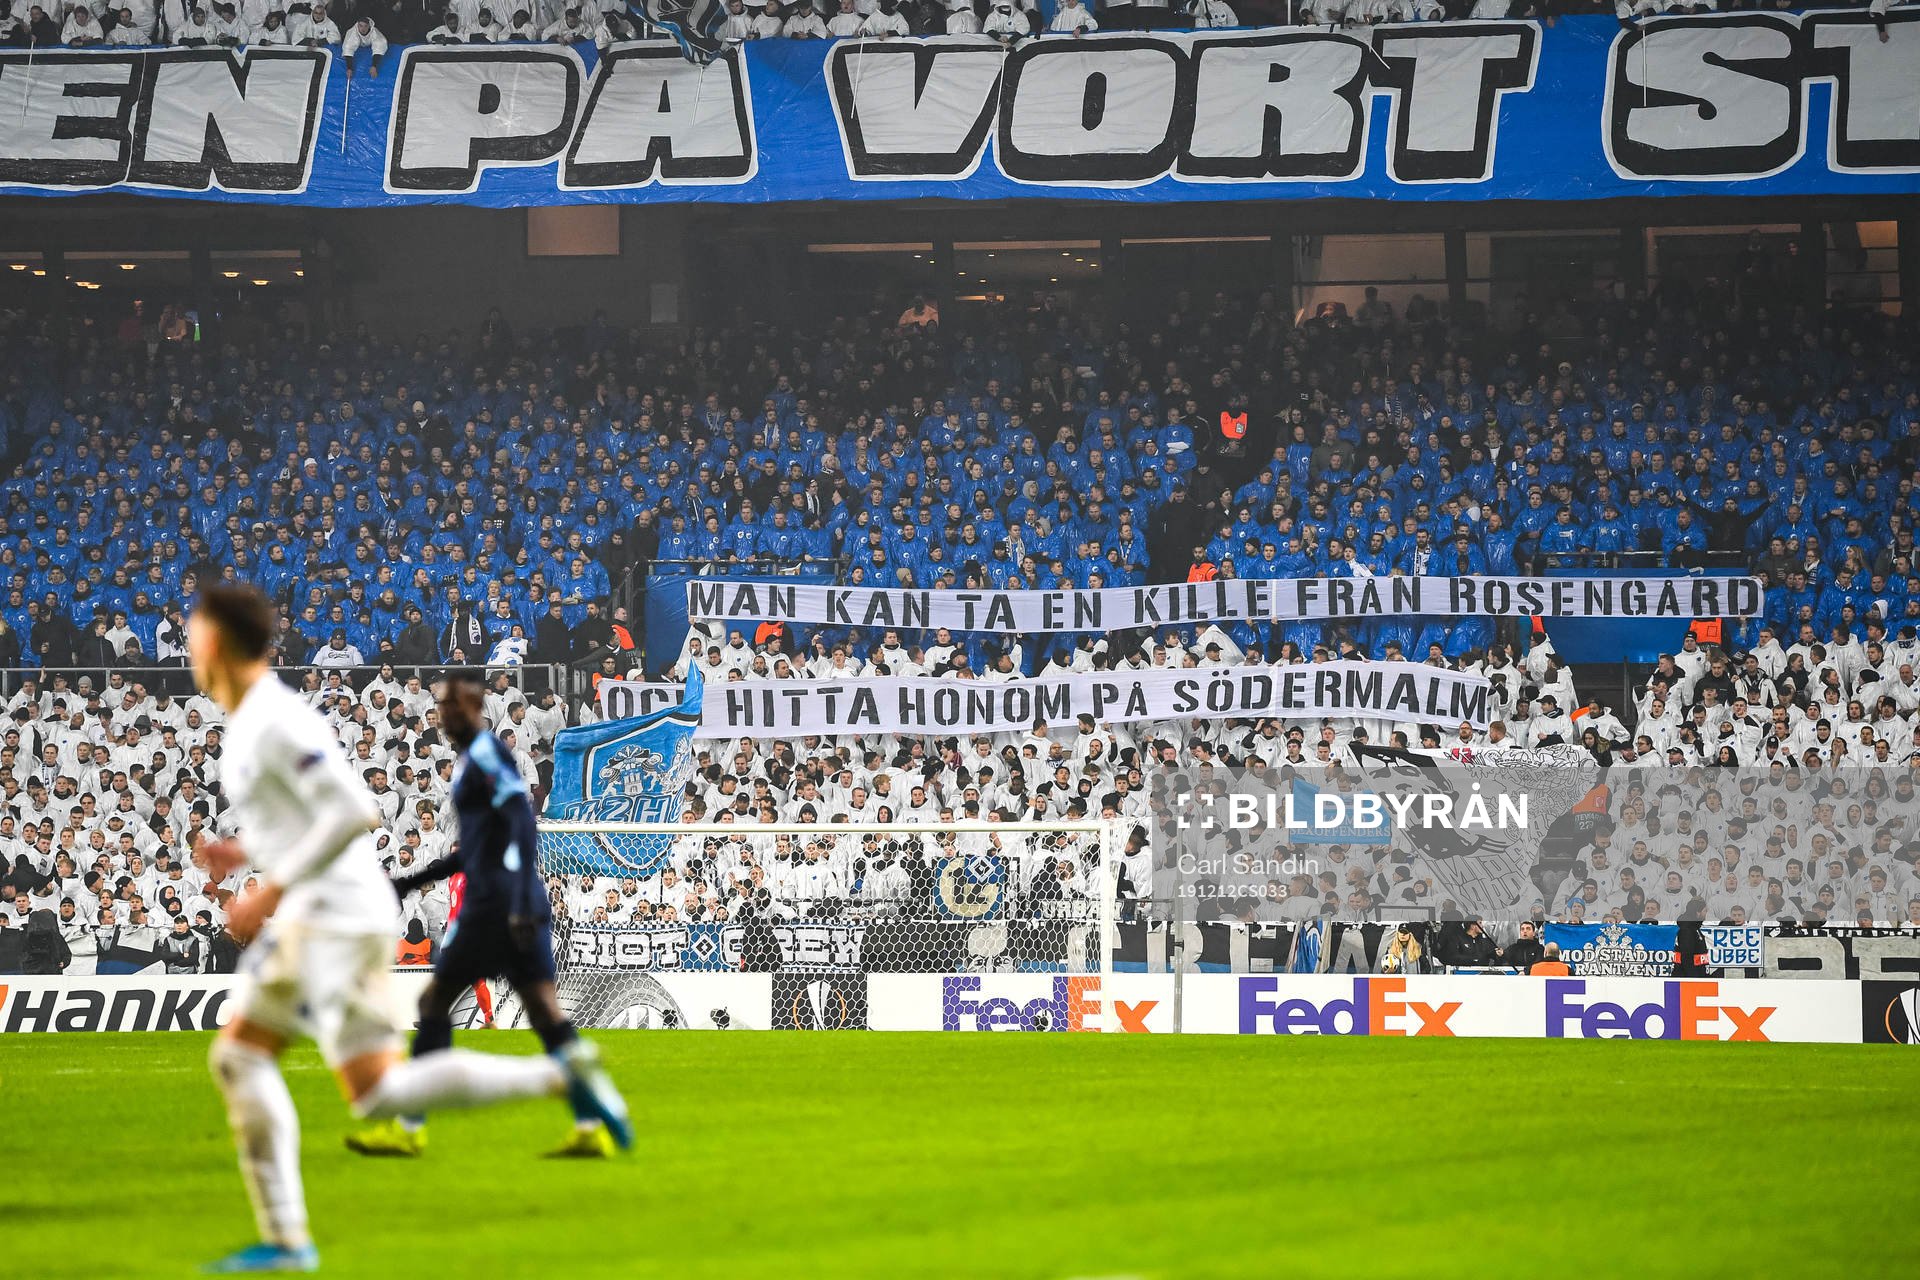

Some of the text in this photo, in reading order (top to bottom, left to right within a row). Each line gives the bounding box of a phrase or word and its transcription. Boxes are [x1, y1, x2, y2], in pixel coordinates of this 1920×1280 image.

[832, 24, 1534, 181] VORT
[690, 577, 1759, 629] MAN KAN TA EN KILLE FRÅN ROSENGÅRD
[726, 687, 881, 727] HITTA
[899, 683, 1071, 727] HONOM
[1092, 681, 1148, 719] PÅ
[1173, 669, 1488, 724] SÖDERMALM
[943, 976, 1160, 1033] FedEx
[1239, 976, 1463, 1037] FedEx
[1545, 979, 1778, 1041] FedEx
